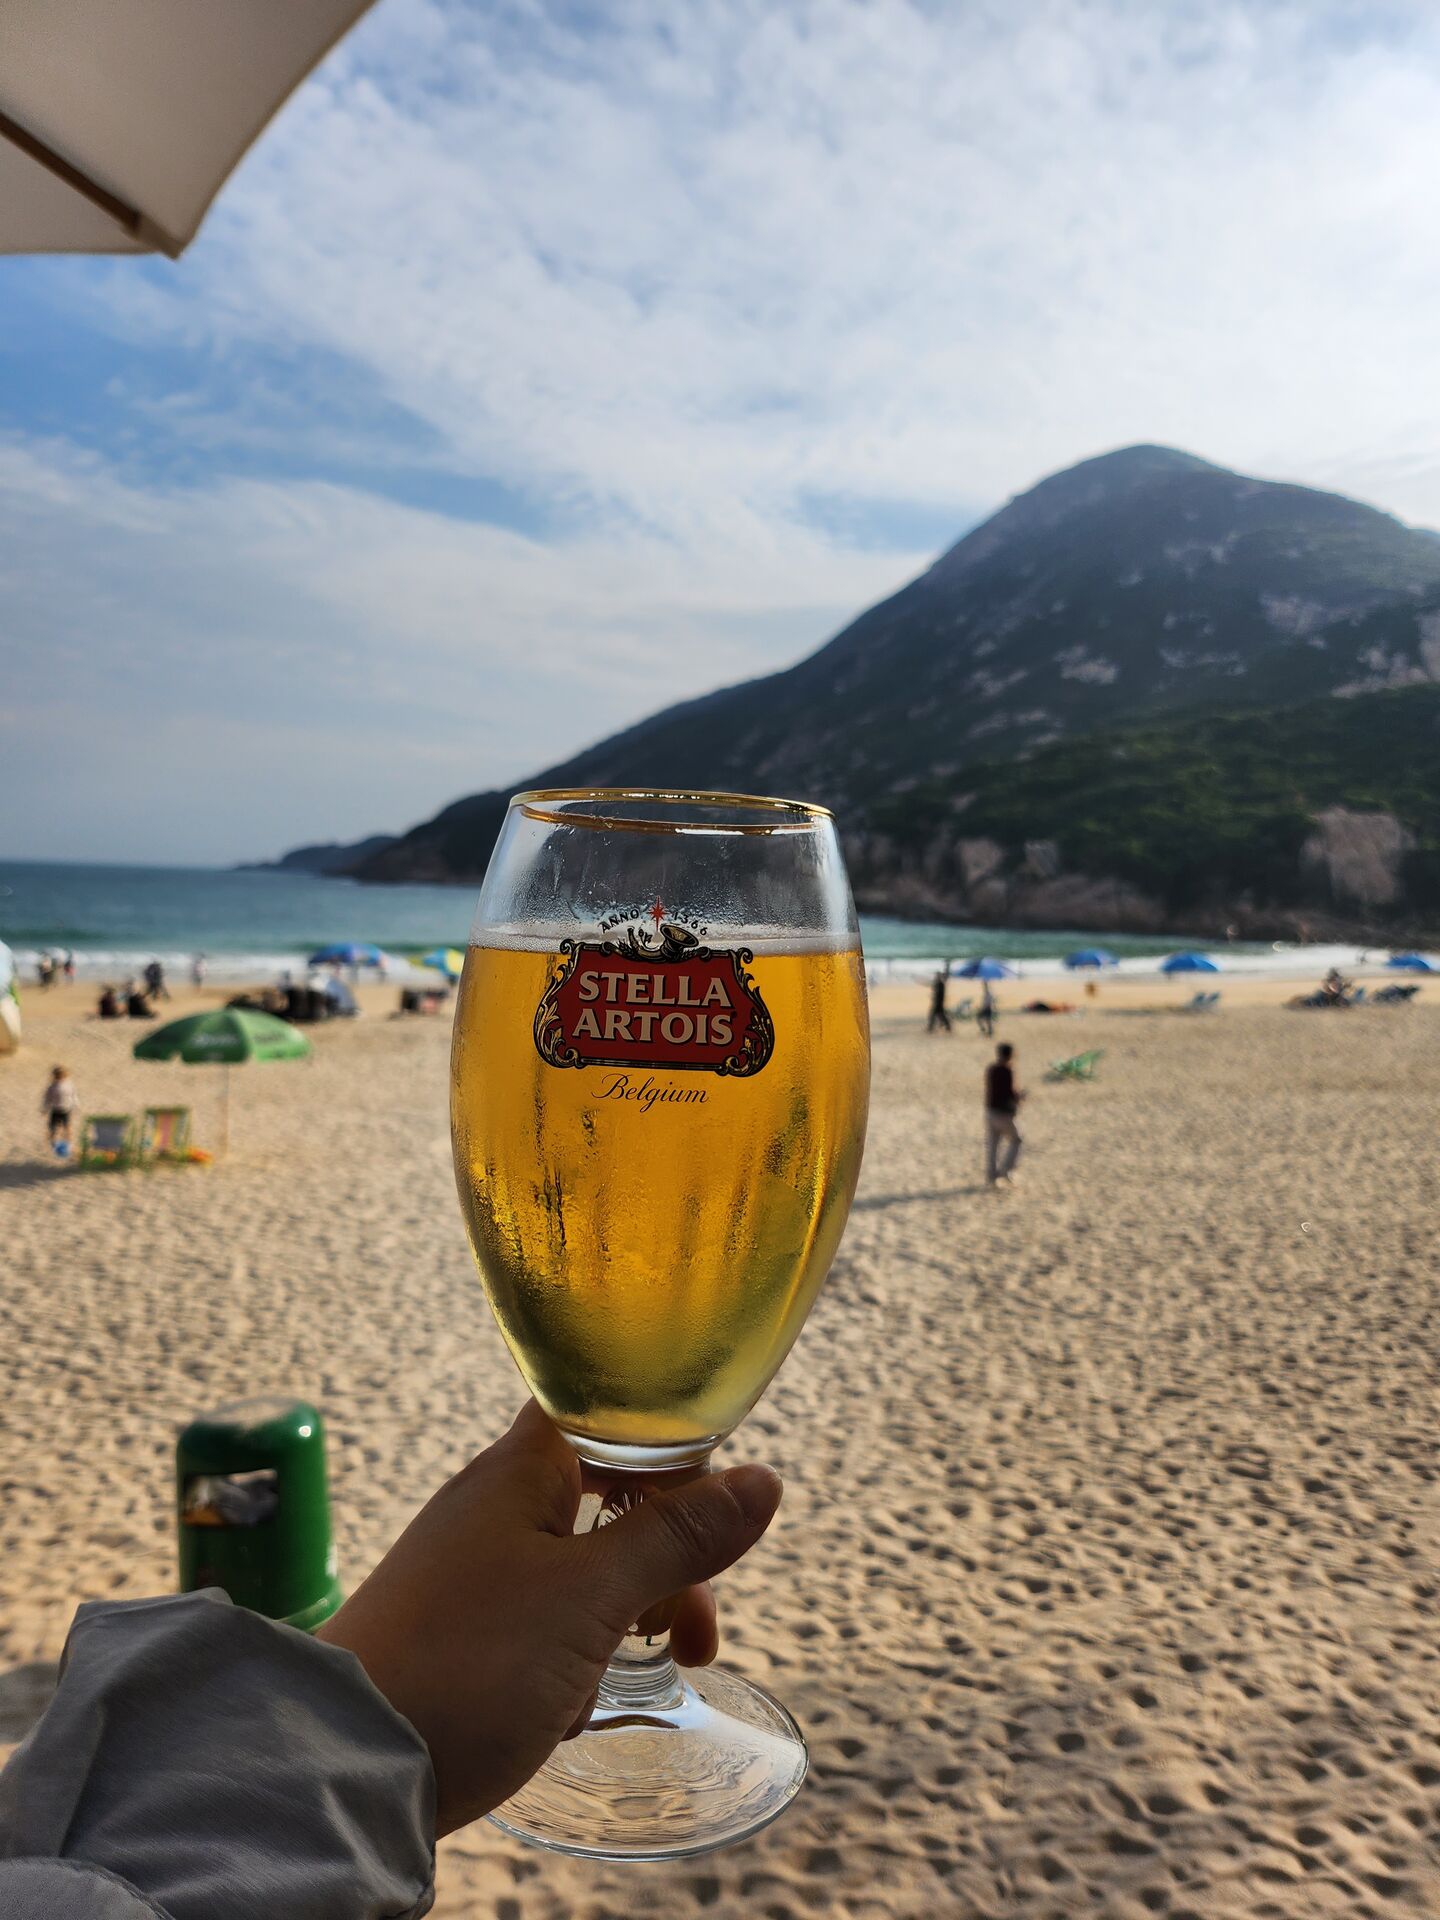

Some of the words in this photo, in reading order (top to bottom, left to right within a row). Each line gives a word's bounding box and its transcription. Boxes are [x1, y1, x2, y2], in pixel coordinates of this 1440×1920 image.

[600, 908, 640, 933] ANNO
[674, 911, 708, 936] 1366
[578, 971, 733, 1008] STELLA
[572, 1008, 734, 1046] ARTOIS
[591, 1073, 710, 1113] Belgium
